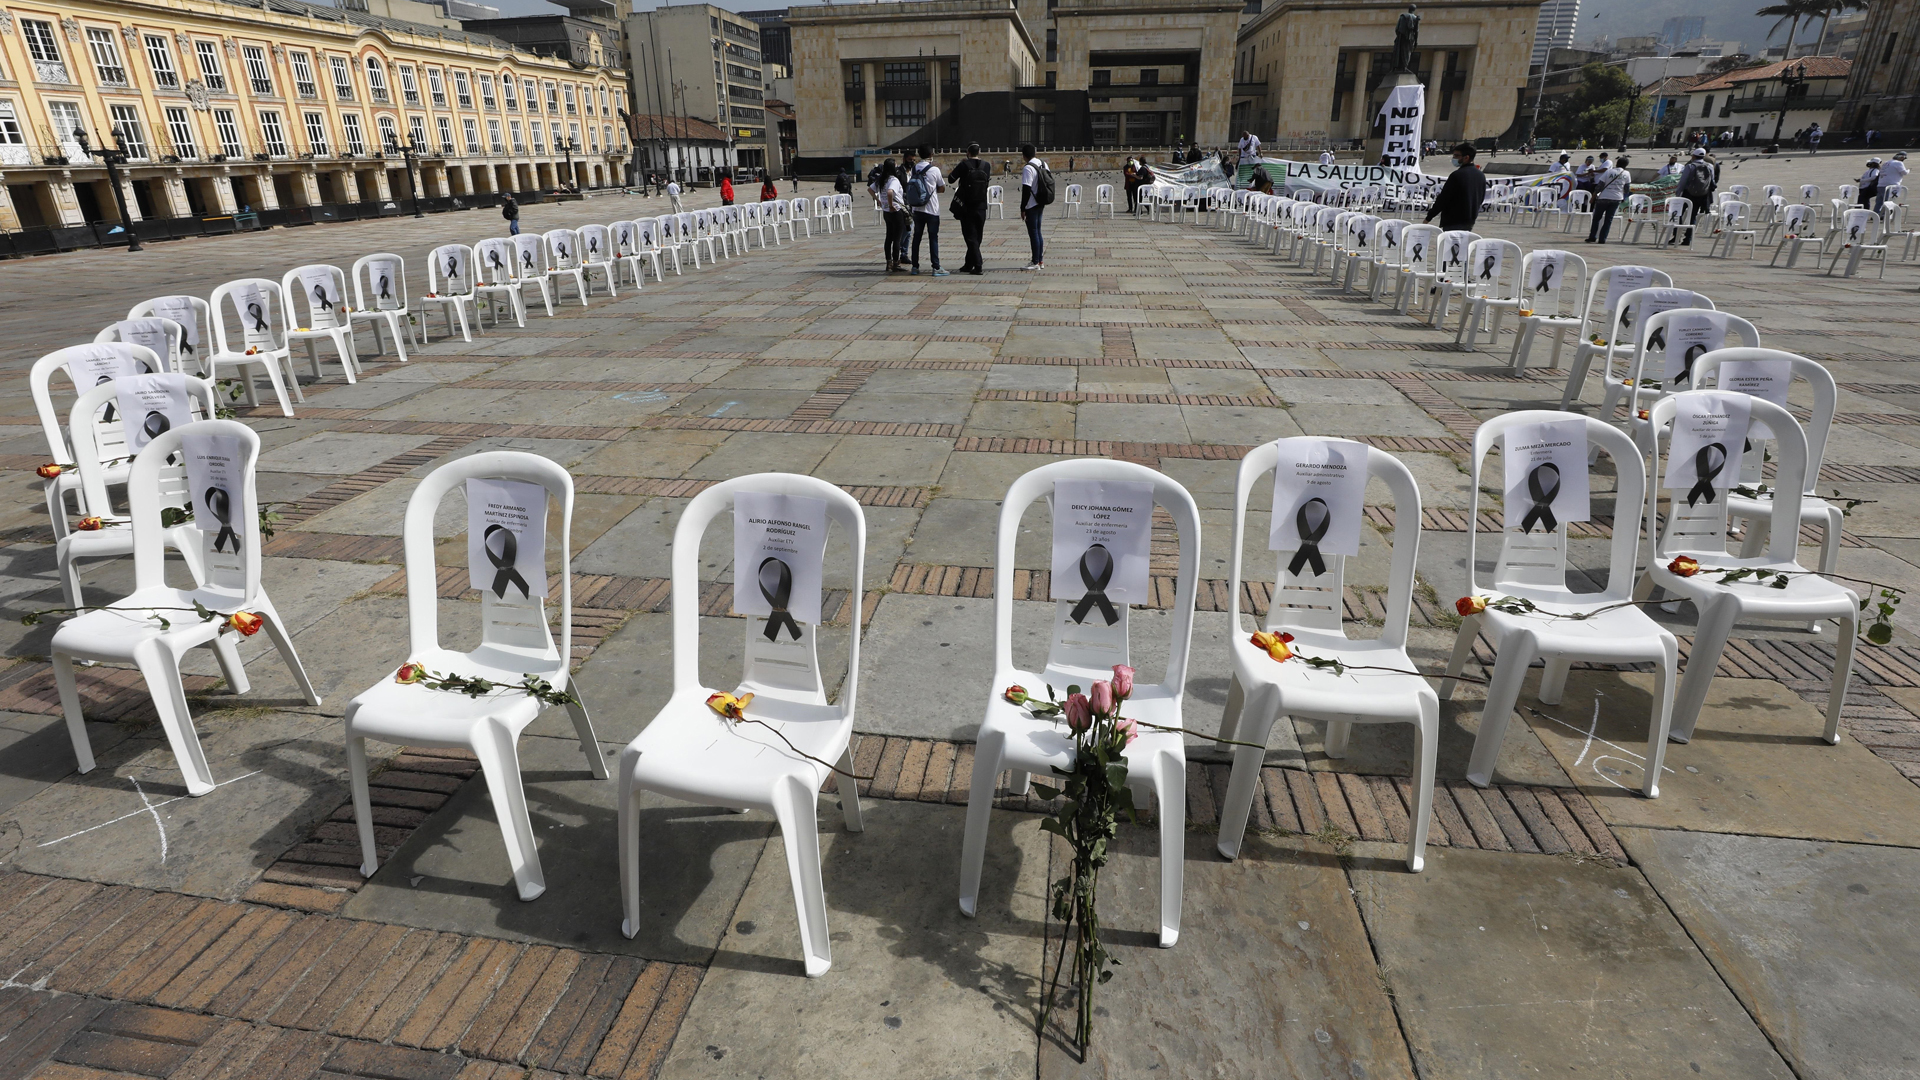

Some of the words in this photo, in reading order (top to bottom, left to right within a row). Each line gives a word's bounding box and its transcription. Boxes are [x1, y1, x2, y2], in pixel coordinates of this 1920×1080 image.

[1391, 107, 1418, 118] NO
[1390, 124, 1413, 136] AL
[1287, 163, 1311, 178] LA
[1317, 164, 1385, 181] SALUD
[1390, 169, 1420, 184] NO
[767, 519, 791, 527] ALFONSO
[792, 523, 811, 531] RANGEL
[766, 527, 796, 536] RODRÍGUEZ
